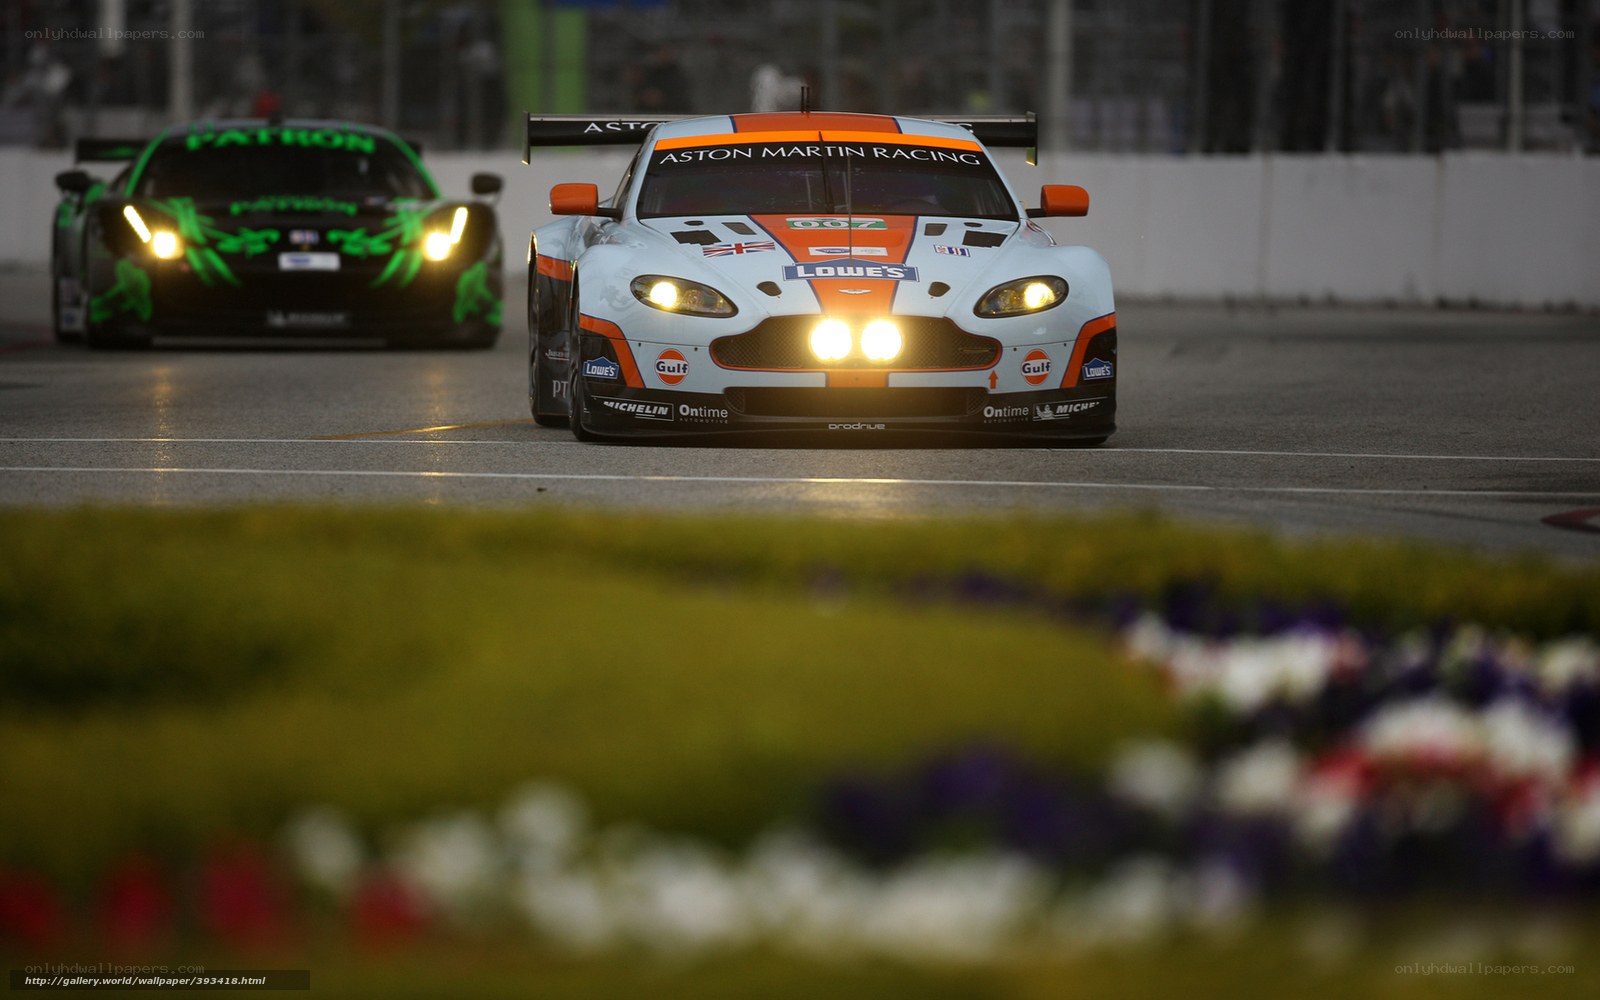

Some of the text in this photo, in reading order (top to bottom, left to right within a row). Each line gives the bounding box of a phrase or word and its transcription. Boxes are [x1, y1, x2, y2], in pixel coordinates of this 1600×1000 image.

[659, 145, 981, 166] ASTON MARTIN RACING
[793, 220, 878, 229] 007
[796, 265, 906, 279] LOWE'S
[586, 363, 616, 377] LOWE'S
[656, 360, 688, 374] Gulf
[1022, 361, 1051, 374] Gulf
[1084, 365, 1111, 378] LOWE'S
[679, 404, 728, 418] Ontime
[983, 405, 1029, 418] Ontime
